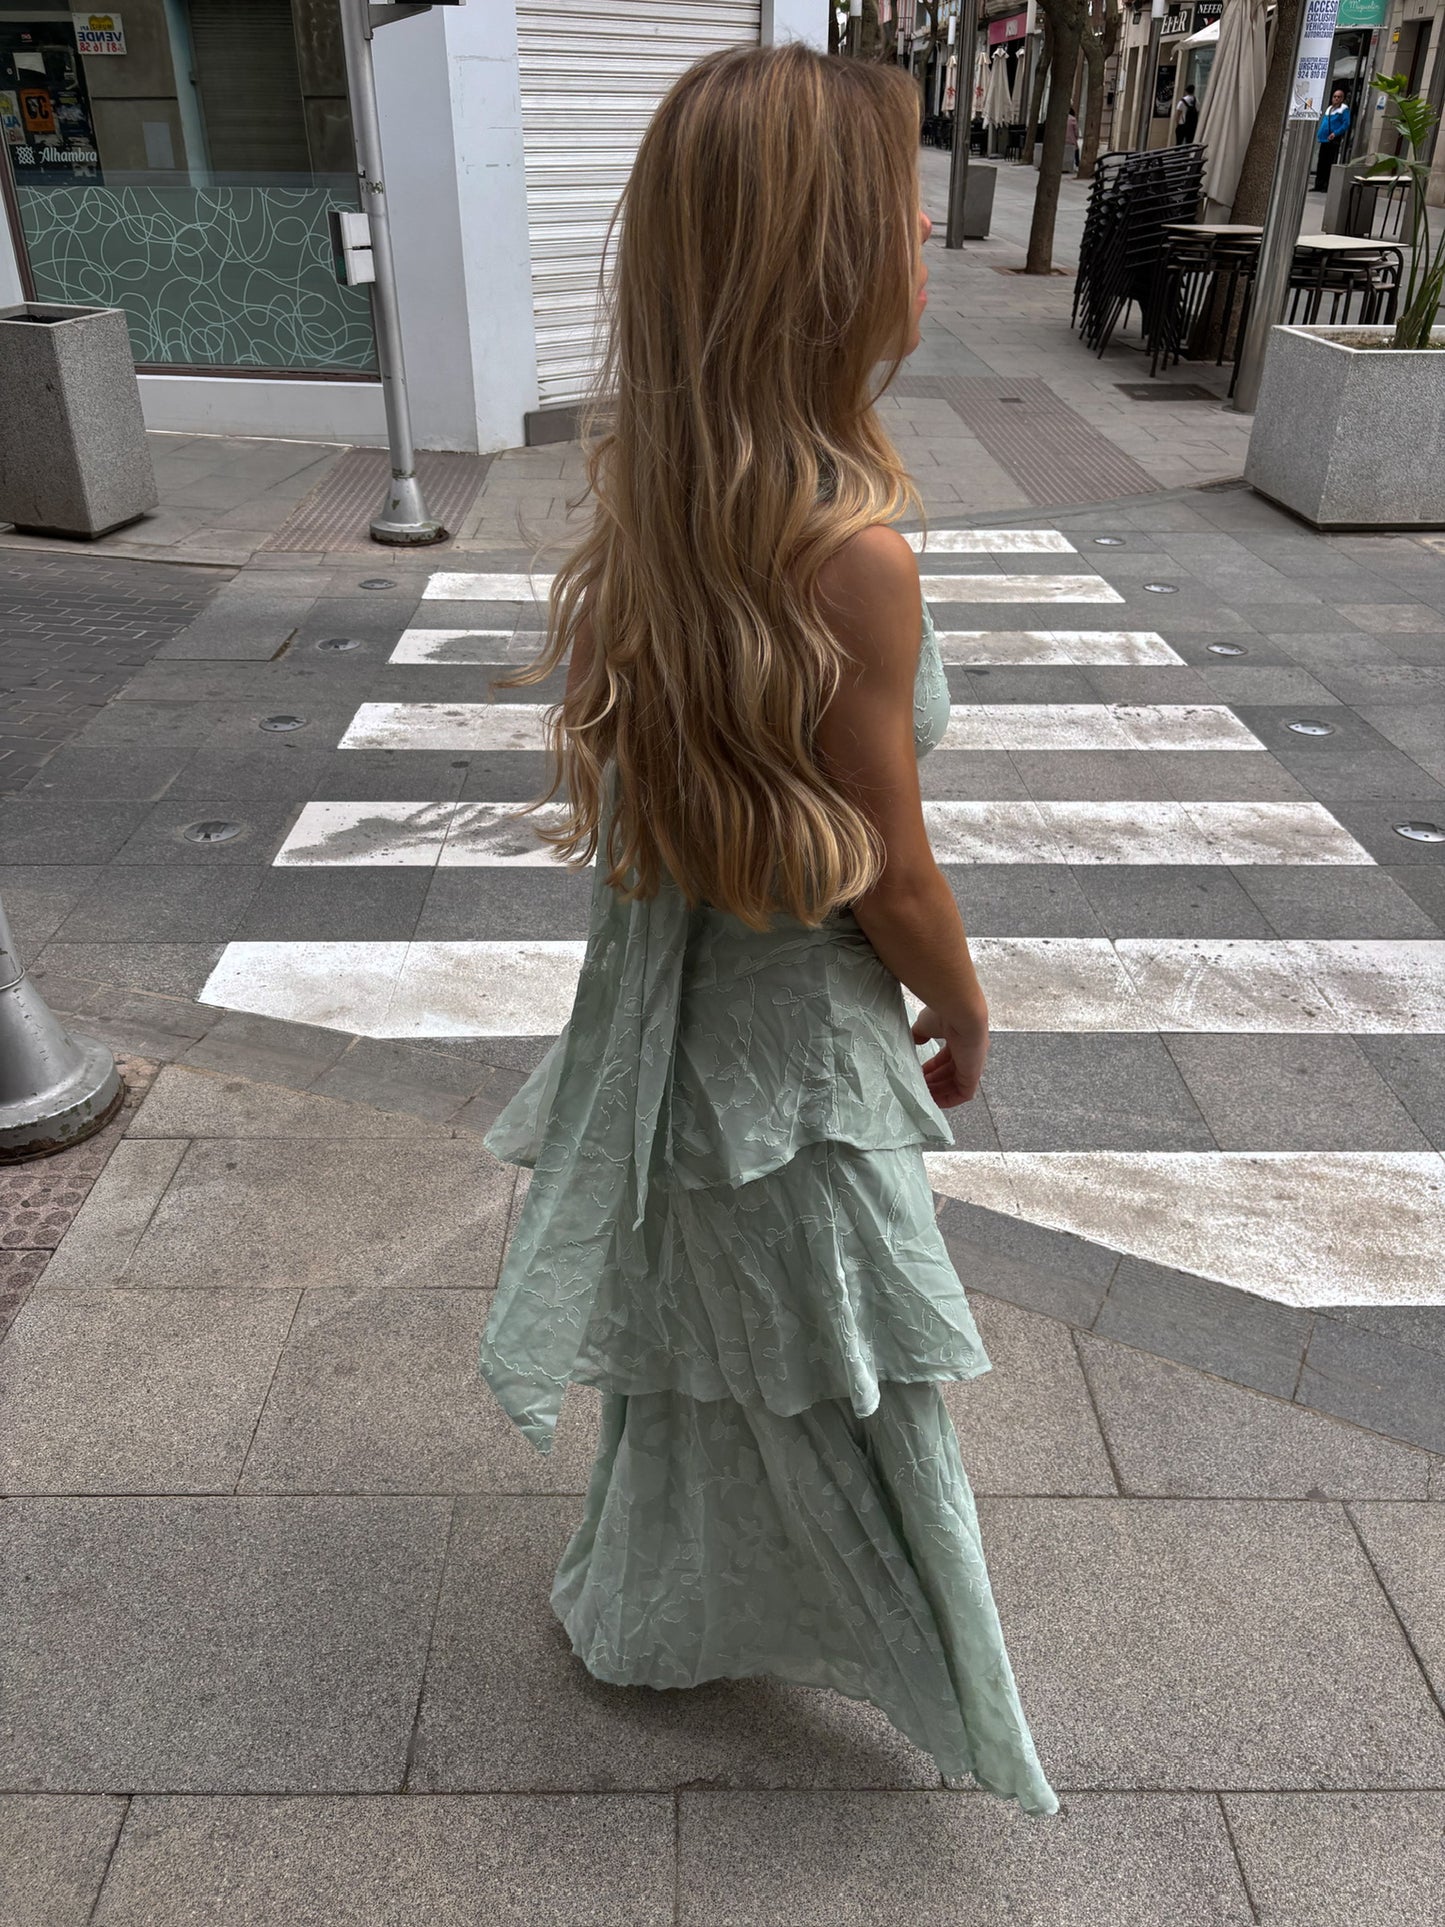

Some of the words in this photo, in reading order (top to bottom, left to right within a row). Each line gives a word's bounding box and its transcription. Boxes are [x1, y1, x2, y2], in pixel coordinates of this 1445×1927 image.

[1197, 4, 1223, 14] NEFER
[1161, 10, 1188, 35] EFER
[1297, 70, 1310, 79] 924
[38, 147, 98, 164] Alhambra
